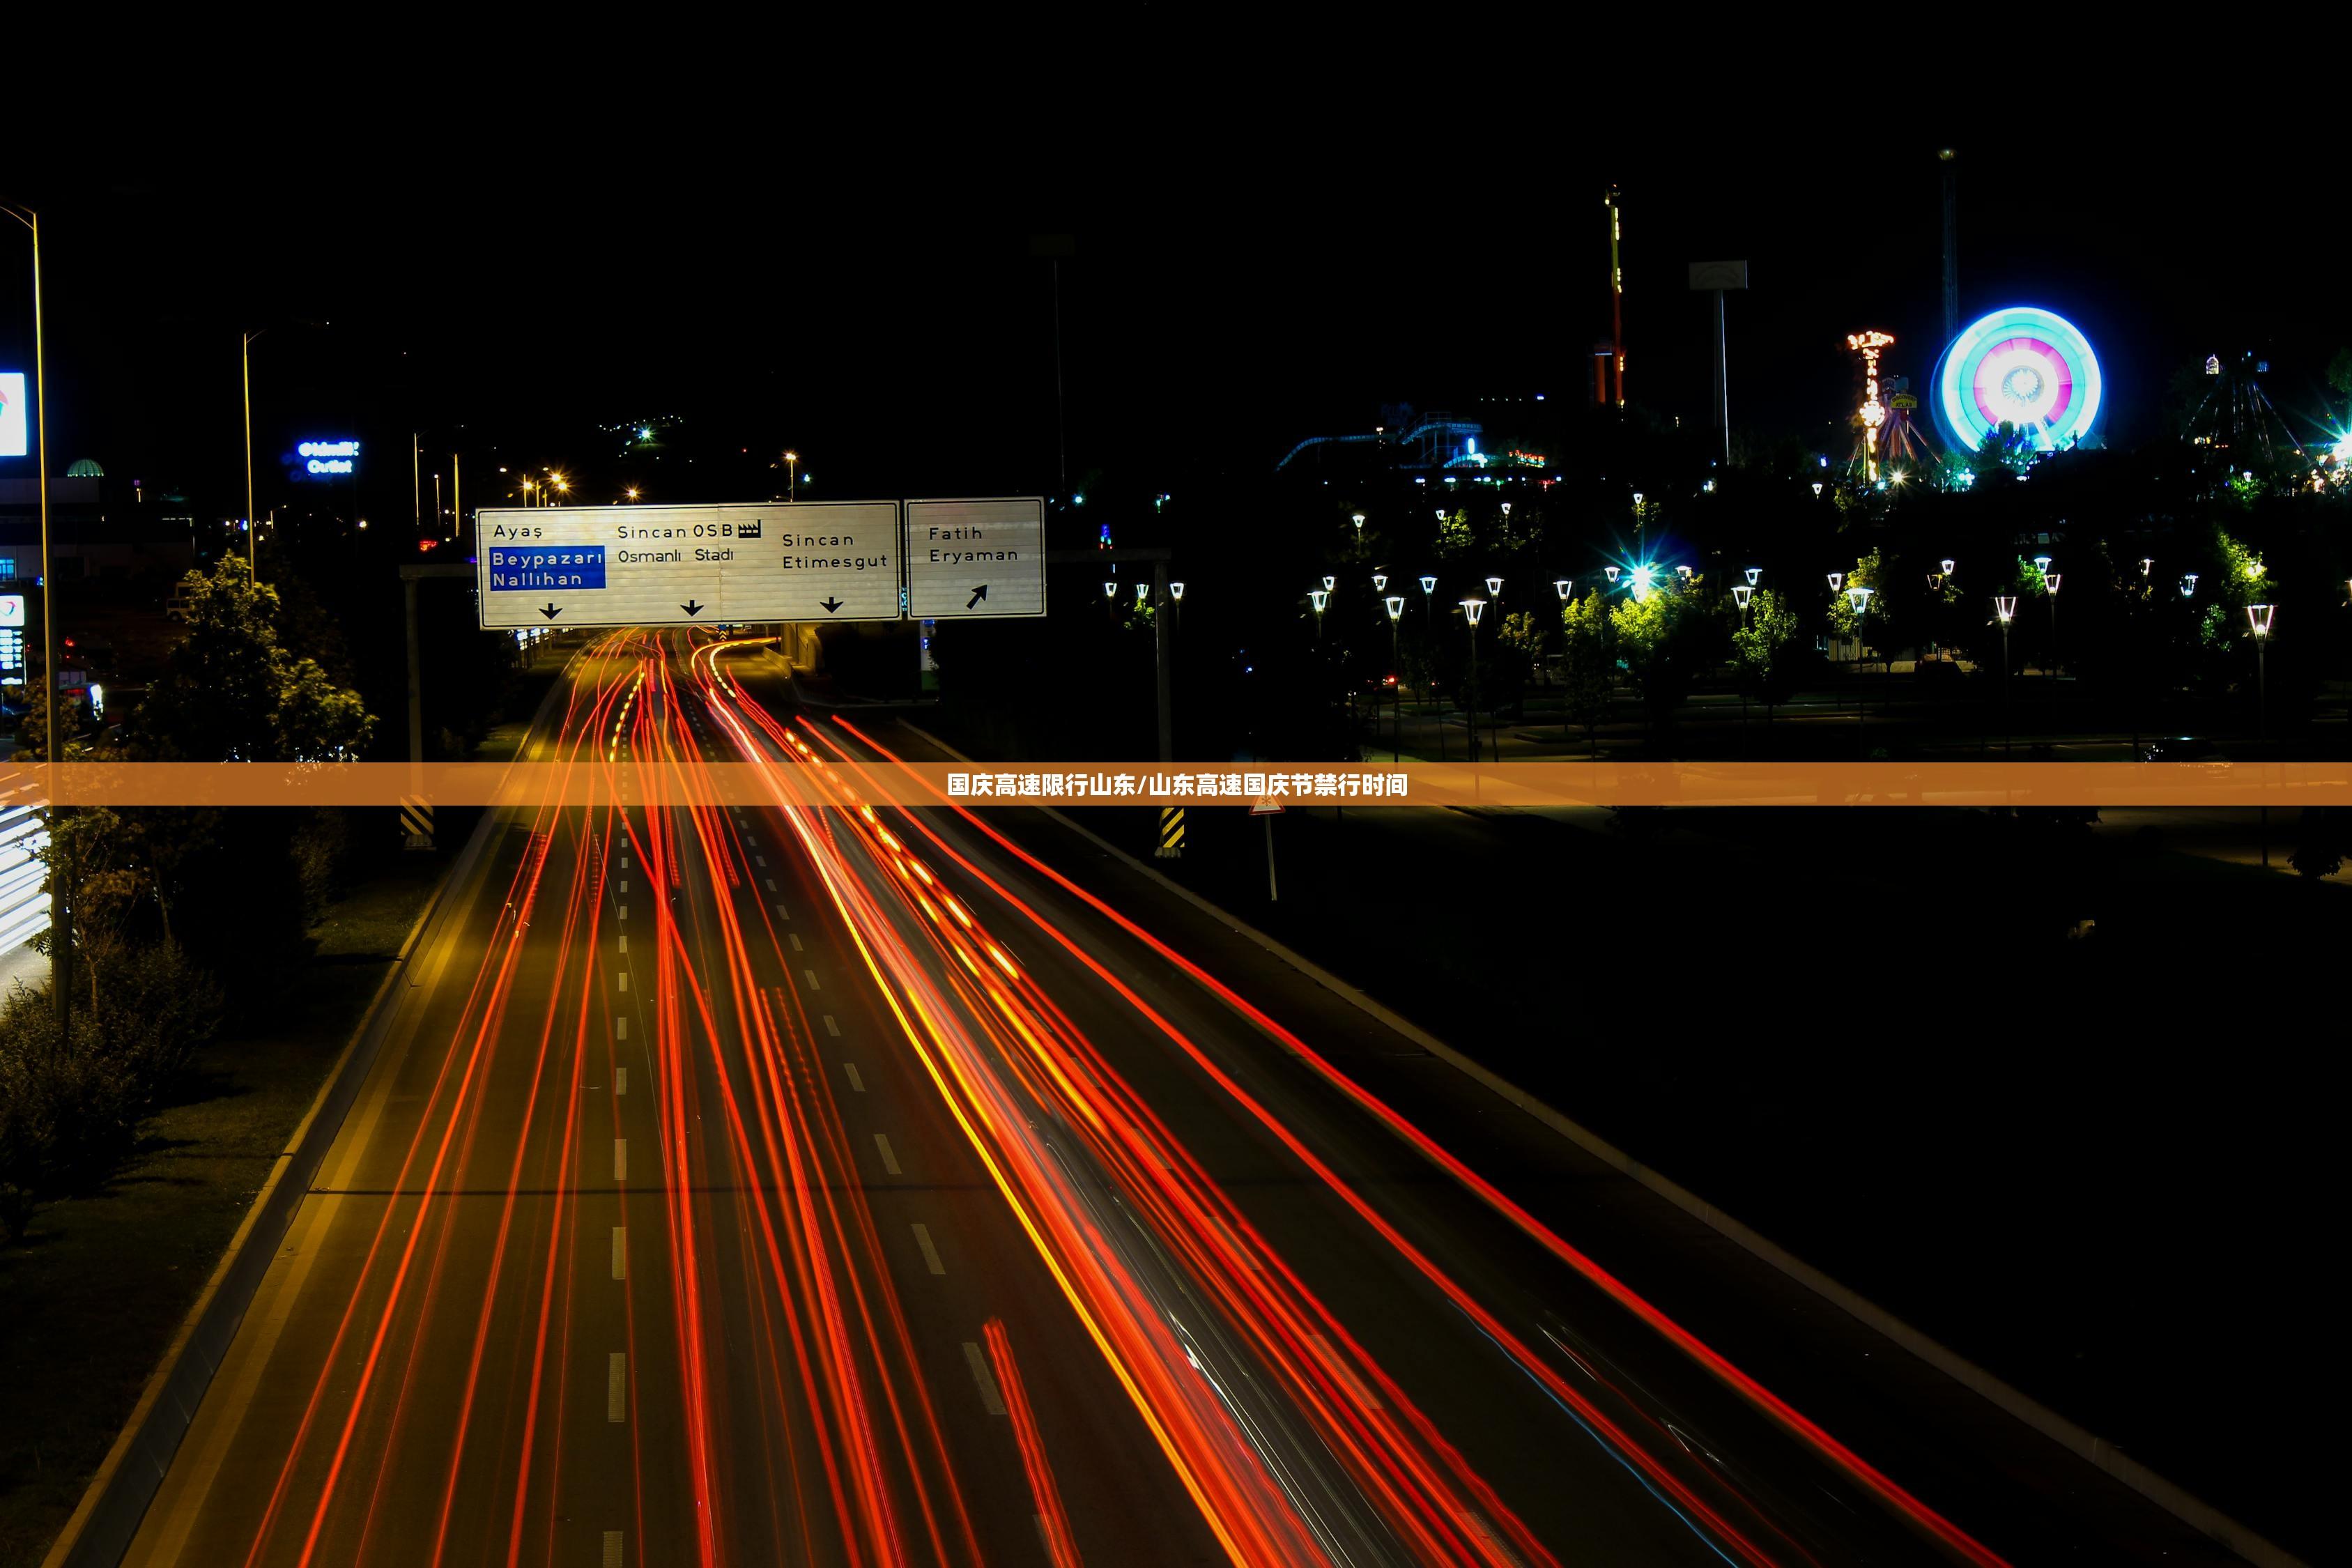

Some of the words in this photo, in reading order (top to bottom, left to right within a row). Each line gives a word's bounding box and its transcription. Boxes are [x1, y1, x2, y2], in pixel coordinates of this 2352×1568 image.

[493, 525, 542, 540] Ayaş
[617, 525, 686, 539] Sincan
[693, 523, 733, 537] OSB
[929, 526, 983, 540] Fatih
[783, 534, 854, 547] Sincan
[493, 552, 601, 569] Beypazarı
[618, 548, 682, 563] Osmanlı
[695, 548, 734, 561] Stadı
[783, 555, 887, 571] Etimesgut
[930, 549, 1018, 564] Eryaman
[493, 572, 582, 587] Nallıhan
